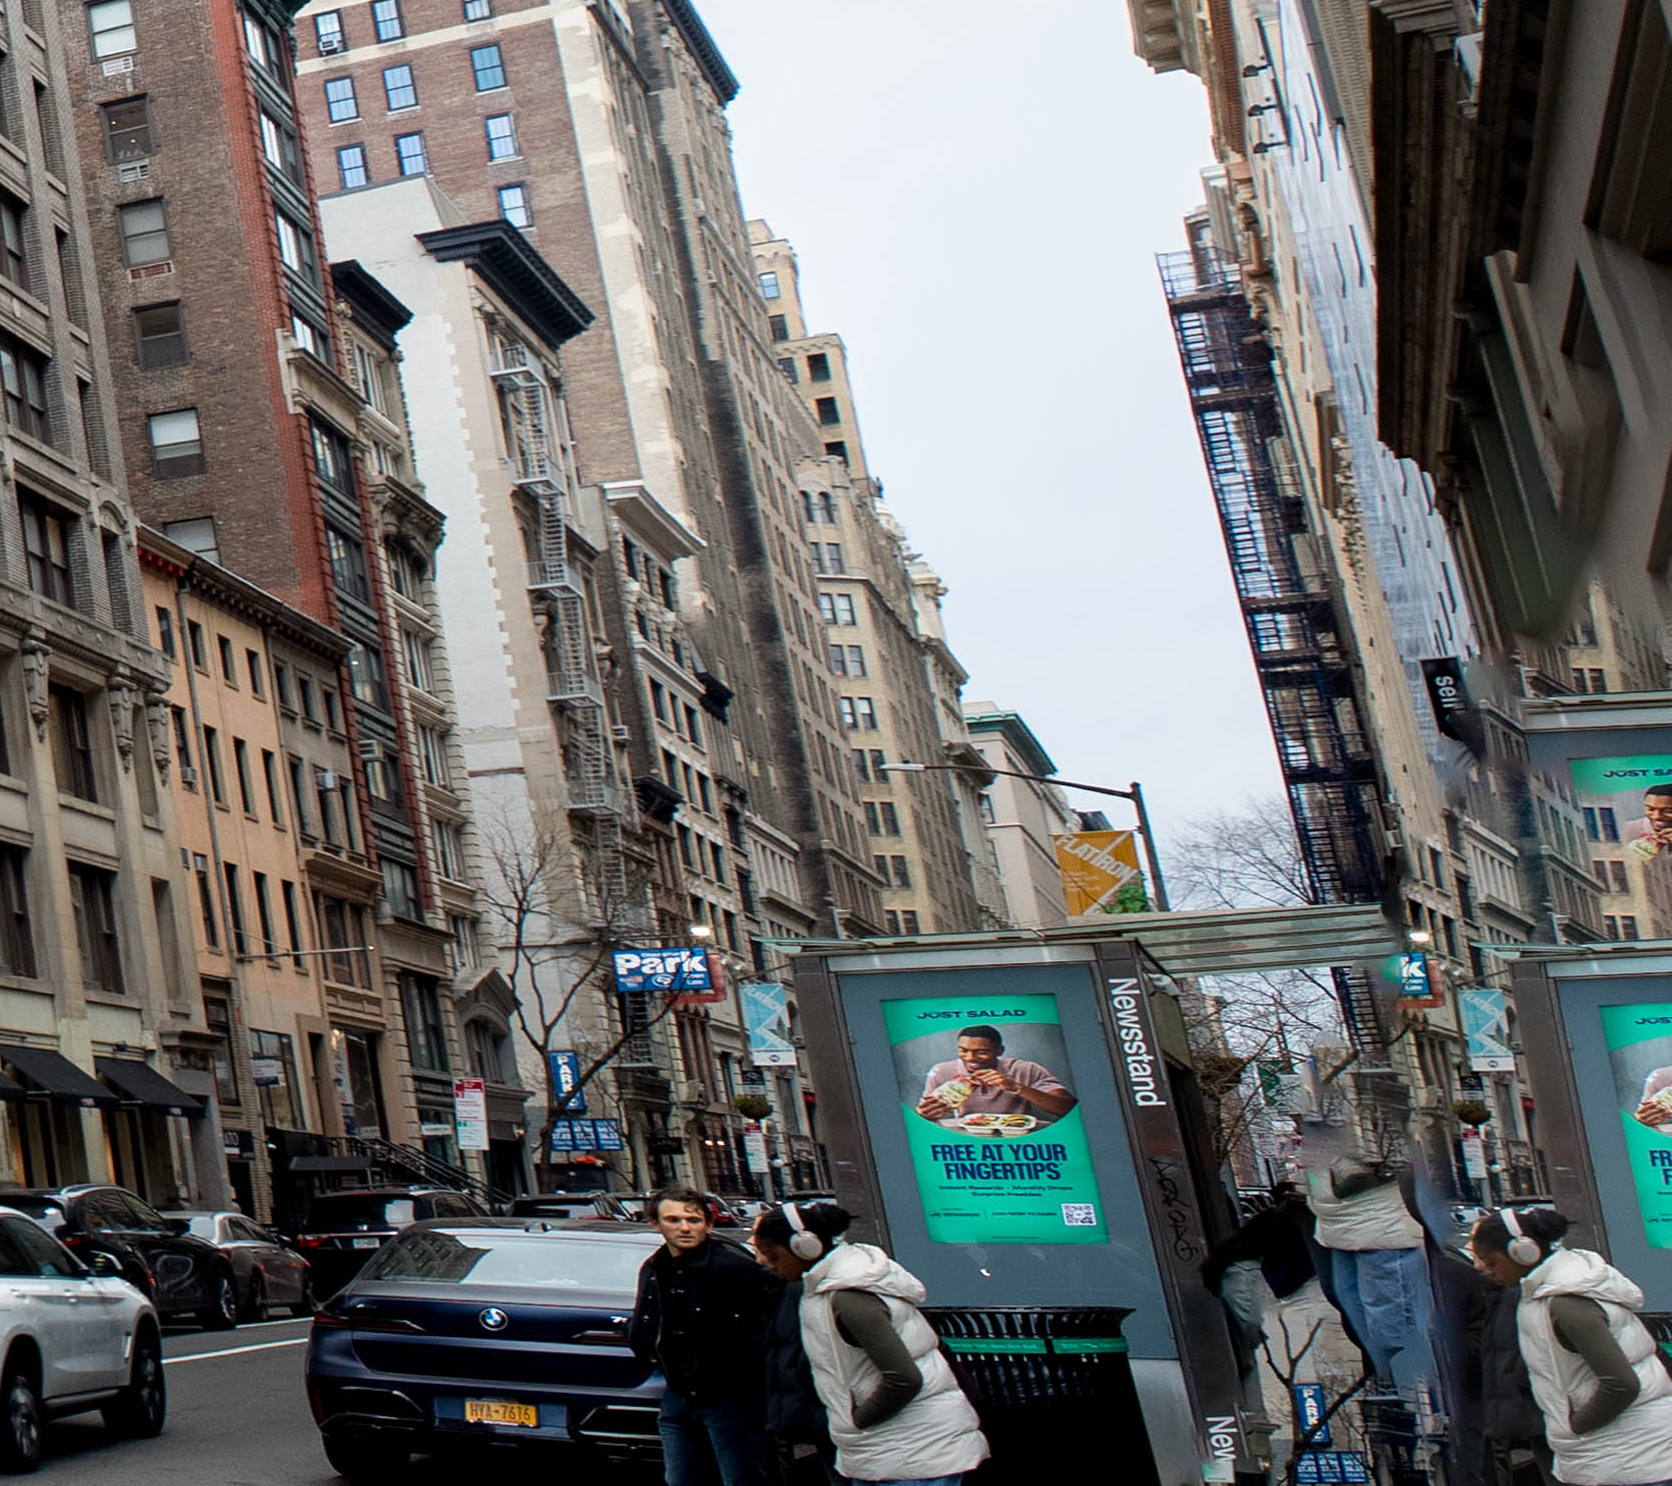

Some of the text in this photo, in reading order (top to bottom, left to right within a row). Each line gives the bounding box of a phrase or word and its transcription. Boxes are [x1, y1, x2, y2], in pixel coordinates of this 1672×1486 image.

[1055, 833, 1137, 880] FLATIRON
[613, 951, 708, 976] Park
[916, 1009, 1026, 1020] JUST SALAD
[1108, 977, 1167, 1107] Newsstand
[930, 1143, 1068, 1162] FREE AT YOUR
[945, 1162, 1062, 1181] FINGERTIPS
